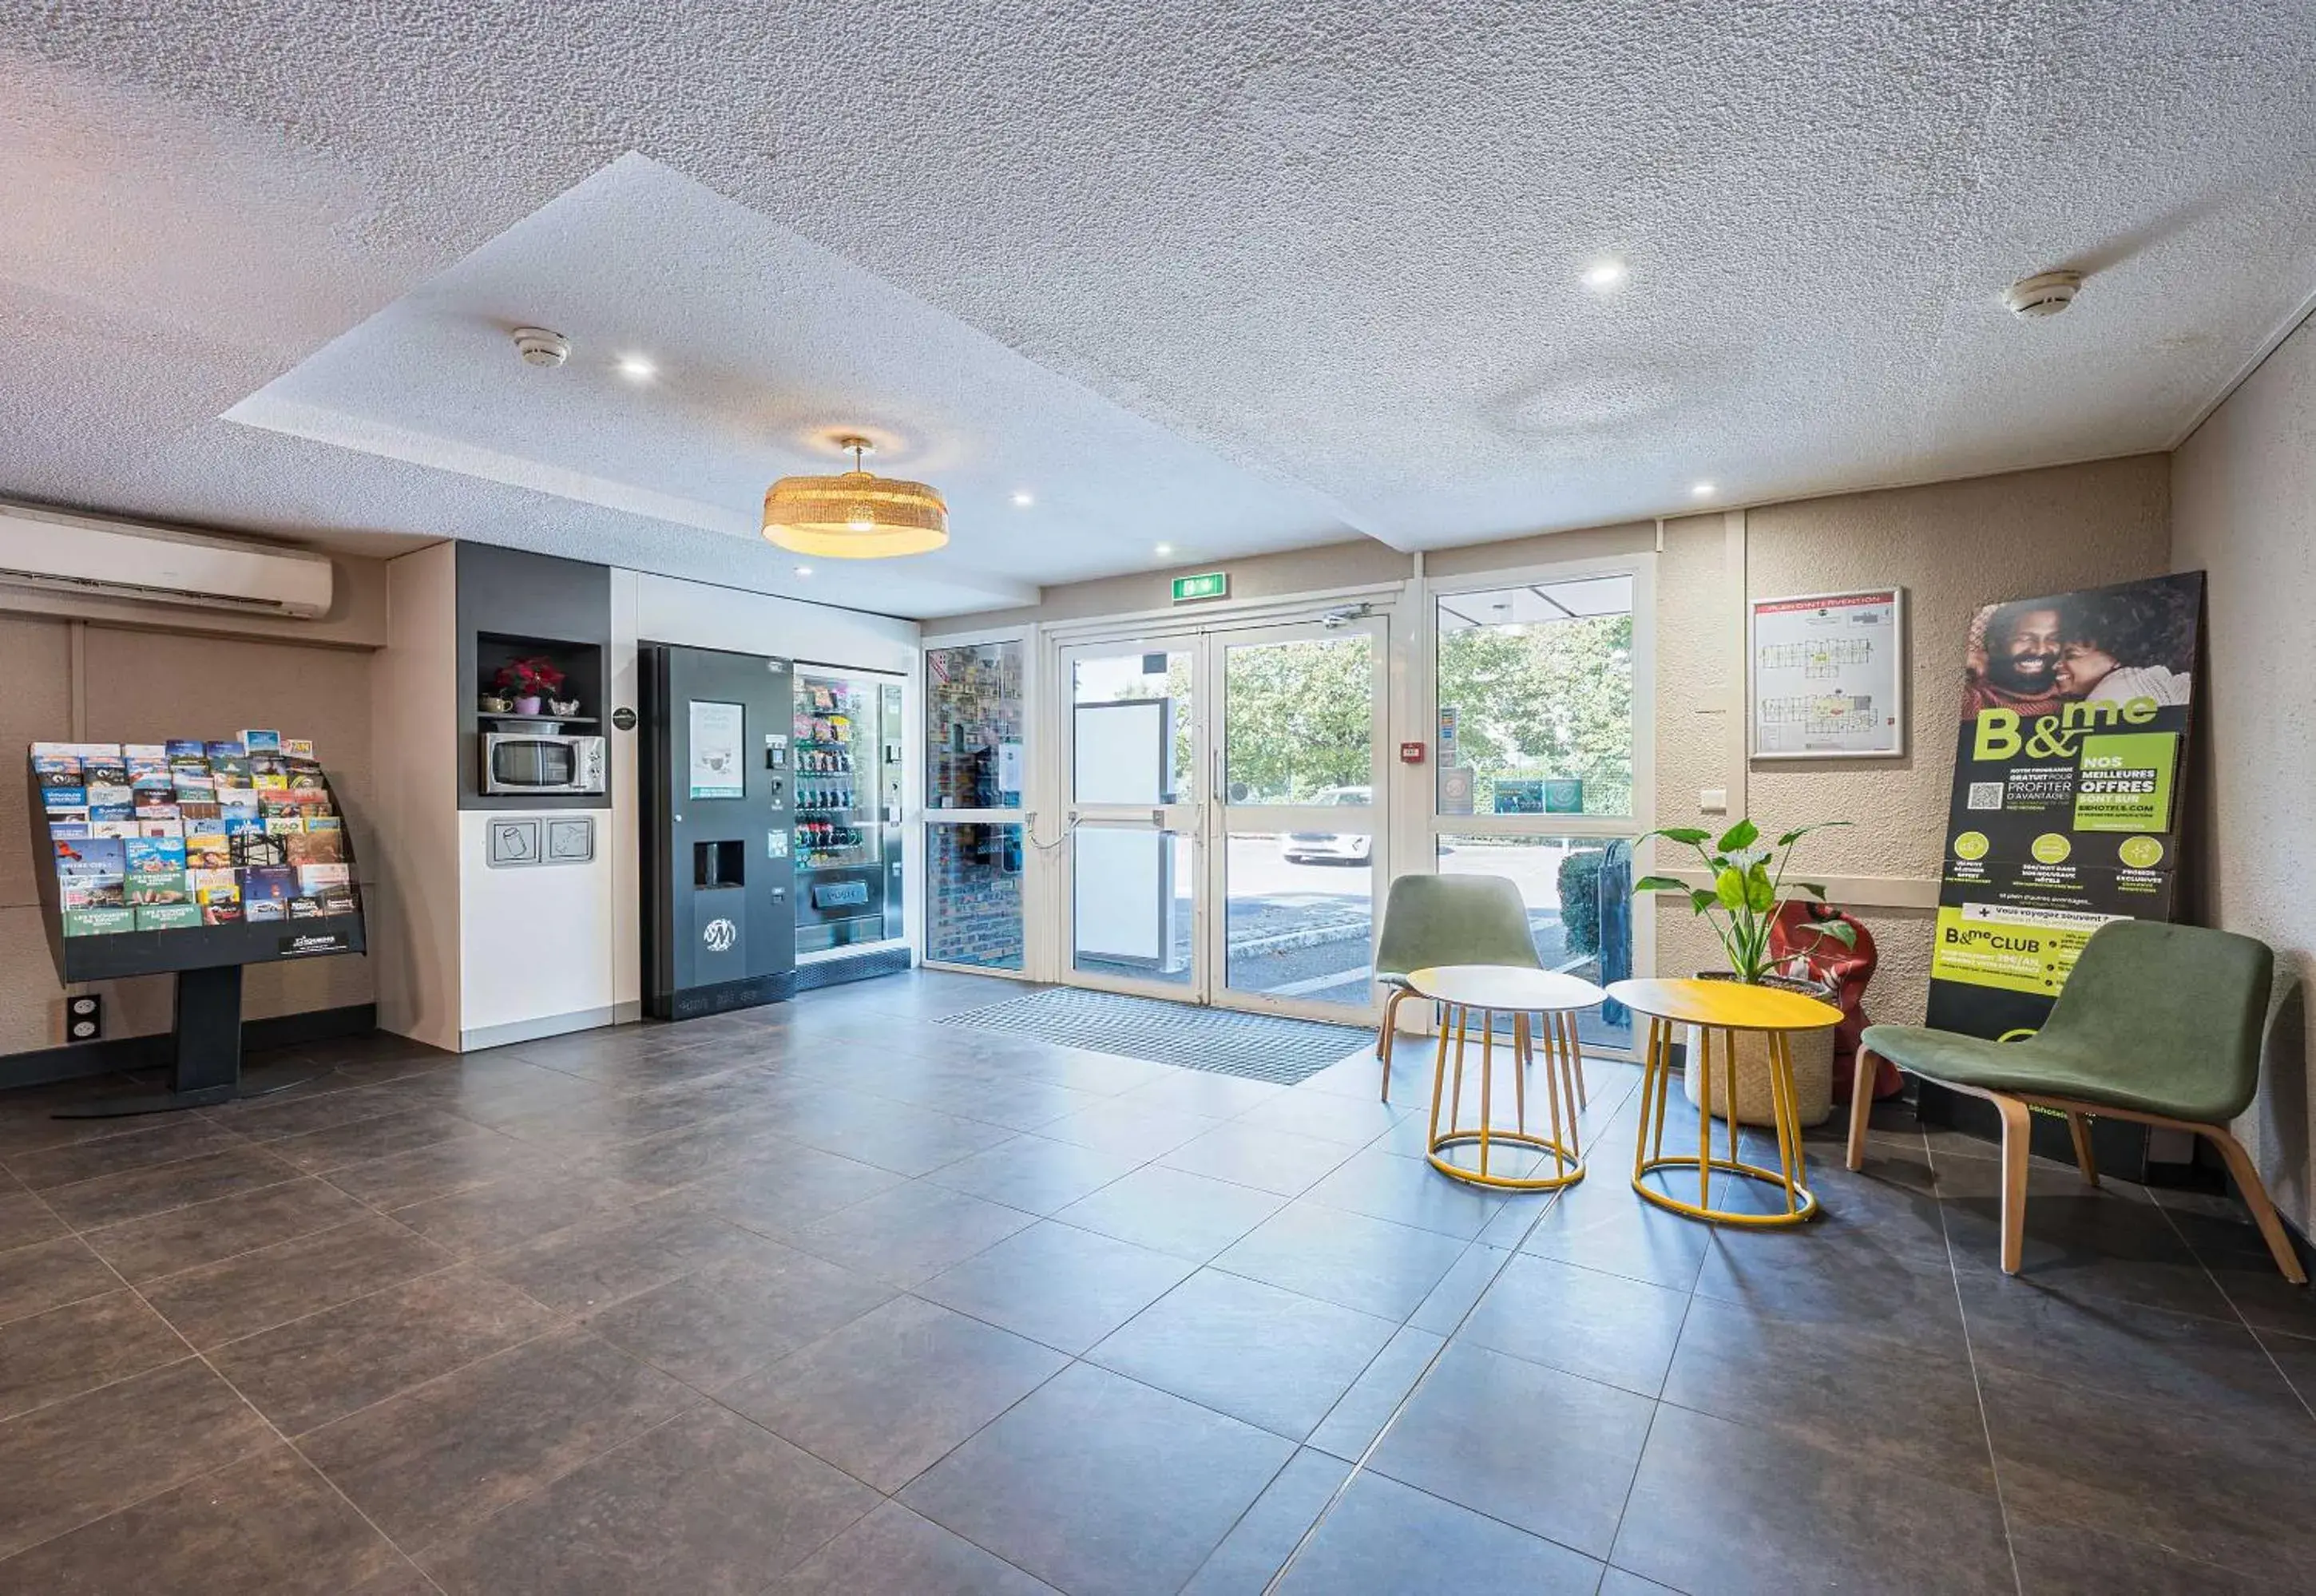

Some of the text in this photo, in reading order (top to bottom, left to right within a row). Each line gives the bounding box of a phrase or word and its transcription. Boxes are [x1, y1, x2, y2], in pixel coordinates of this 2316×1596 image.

[1973, 695, 2159, 762] B&me
[2084, 756, 2124, 768] NOS
[2082, 770, 2155, 779] MEILLEURES
[2008, 781, 2072, 792] PROFITER
[2080, 781, 2155, 793] OFFRES
[2020, 909, 2059, 919] voyagez
[2060, 913, 2101, 922] souvent
[1945, 927, 1991, 946] B&me
[1991, 937, 2040, 953] CLUB
